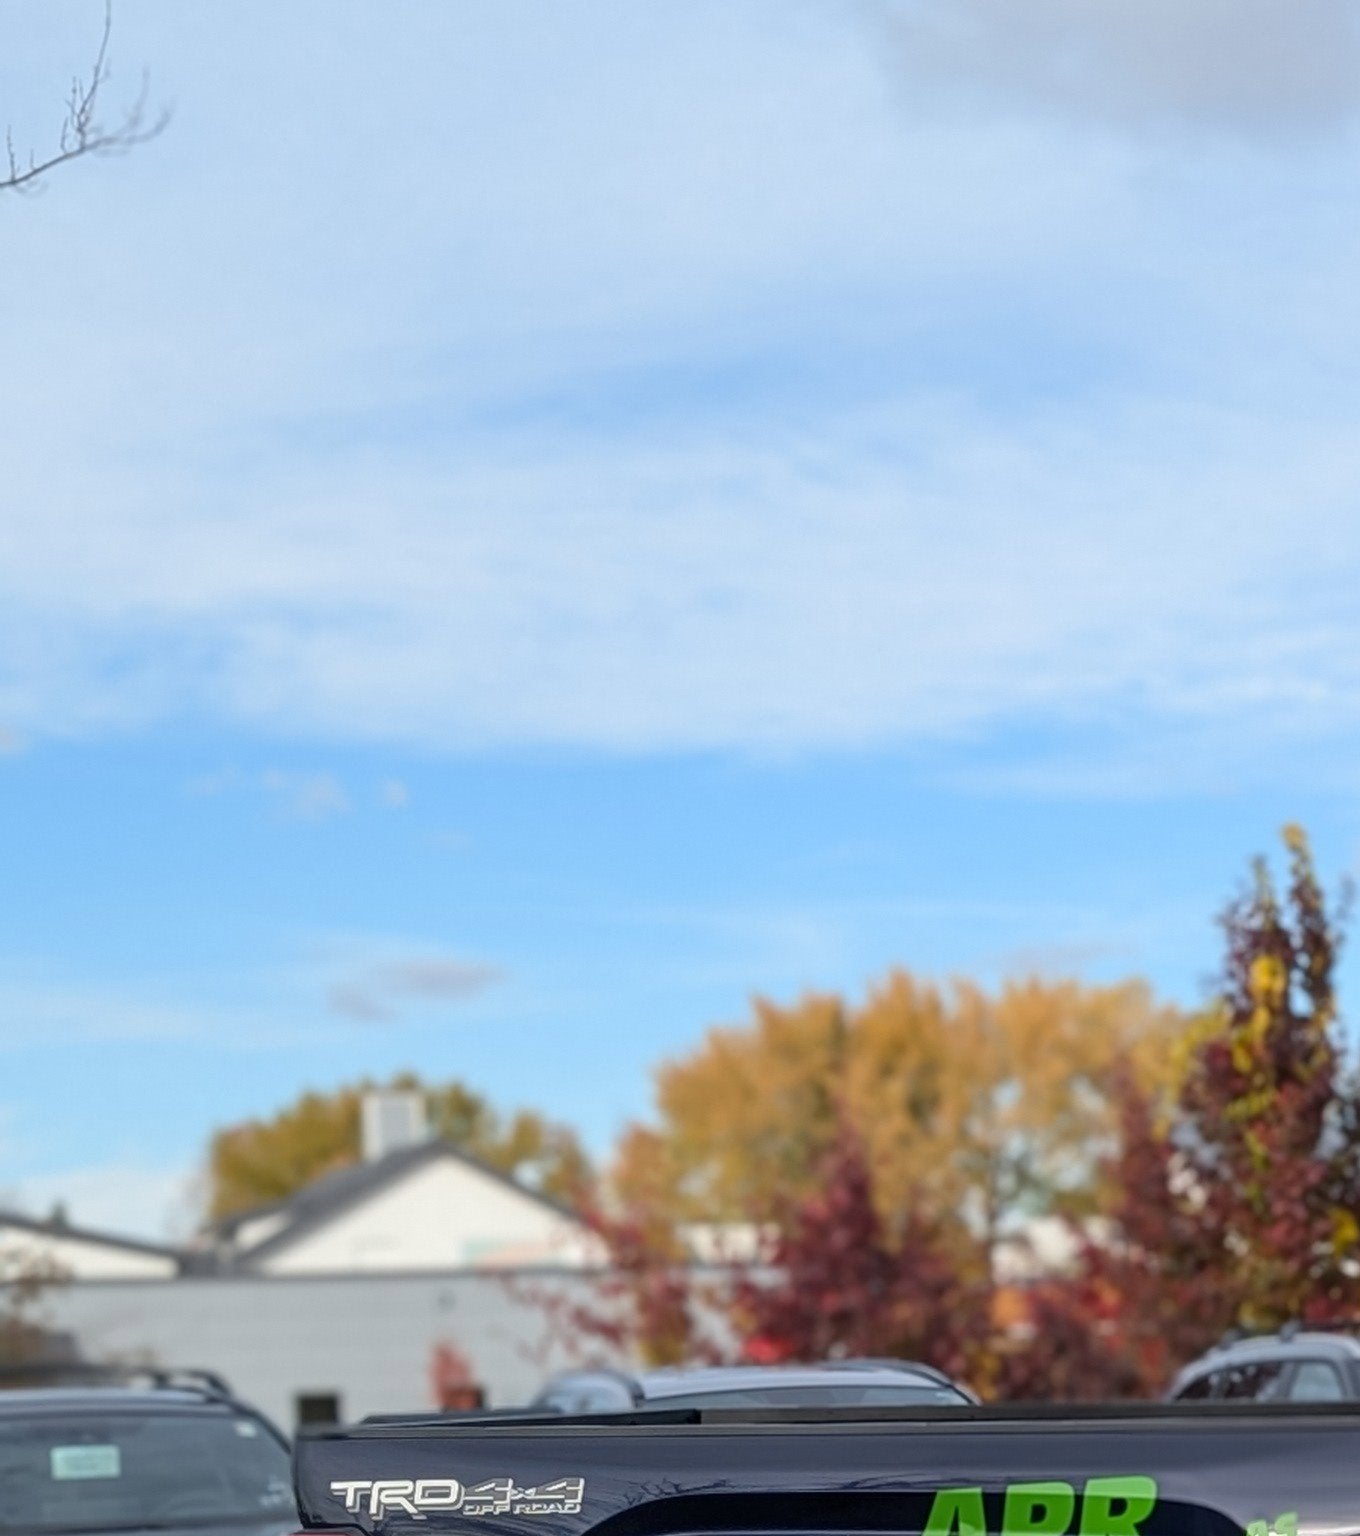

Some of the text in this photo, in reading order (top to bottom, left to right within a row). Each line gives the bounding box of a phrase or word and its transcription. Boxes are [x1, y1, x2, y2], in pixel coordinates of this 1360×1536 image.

[330, 1479, 465, 1520] TRD
[463, 1503, 582, 1515] OFF ROAD
